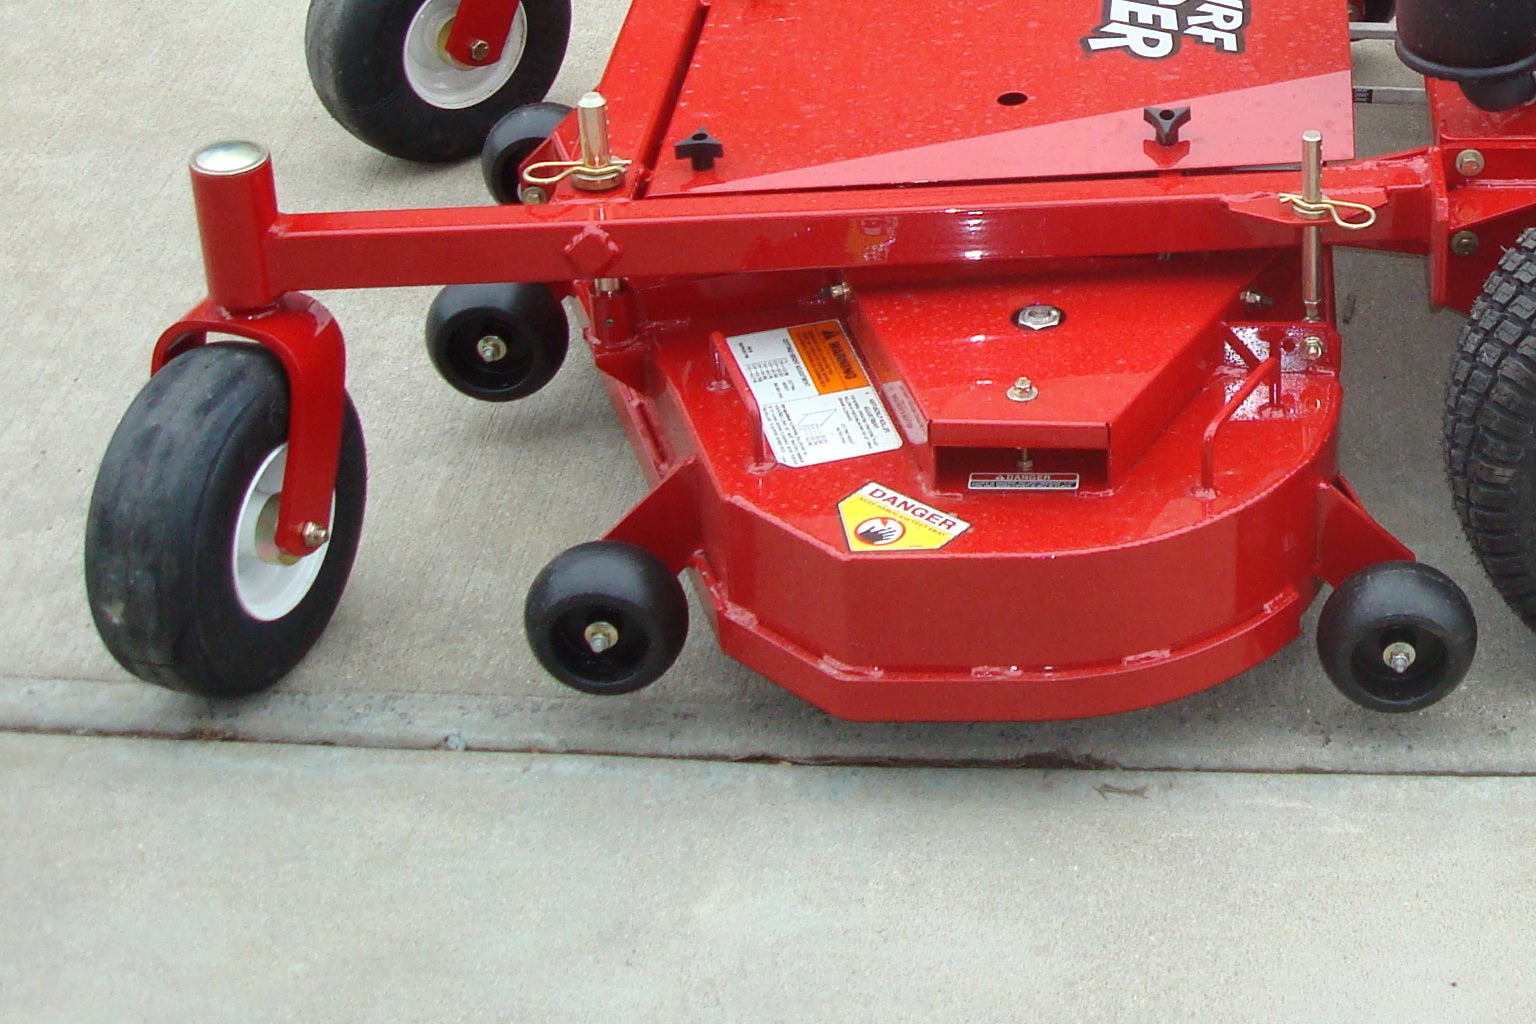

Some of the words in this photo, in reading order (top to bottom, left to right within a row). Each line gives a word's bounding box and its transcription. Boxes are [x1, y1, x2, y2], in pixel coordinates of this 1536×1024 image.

[829, 341, 857, 380] WARNING
[1006, 472, 1051, 480] DANGER
[868, 487, 957, 532] DANGER
